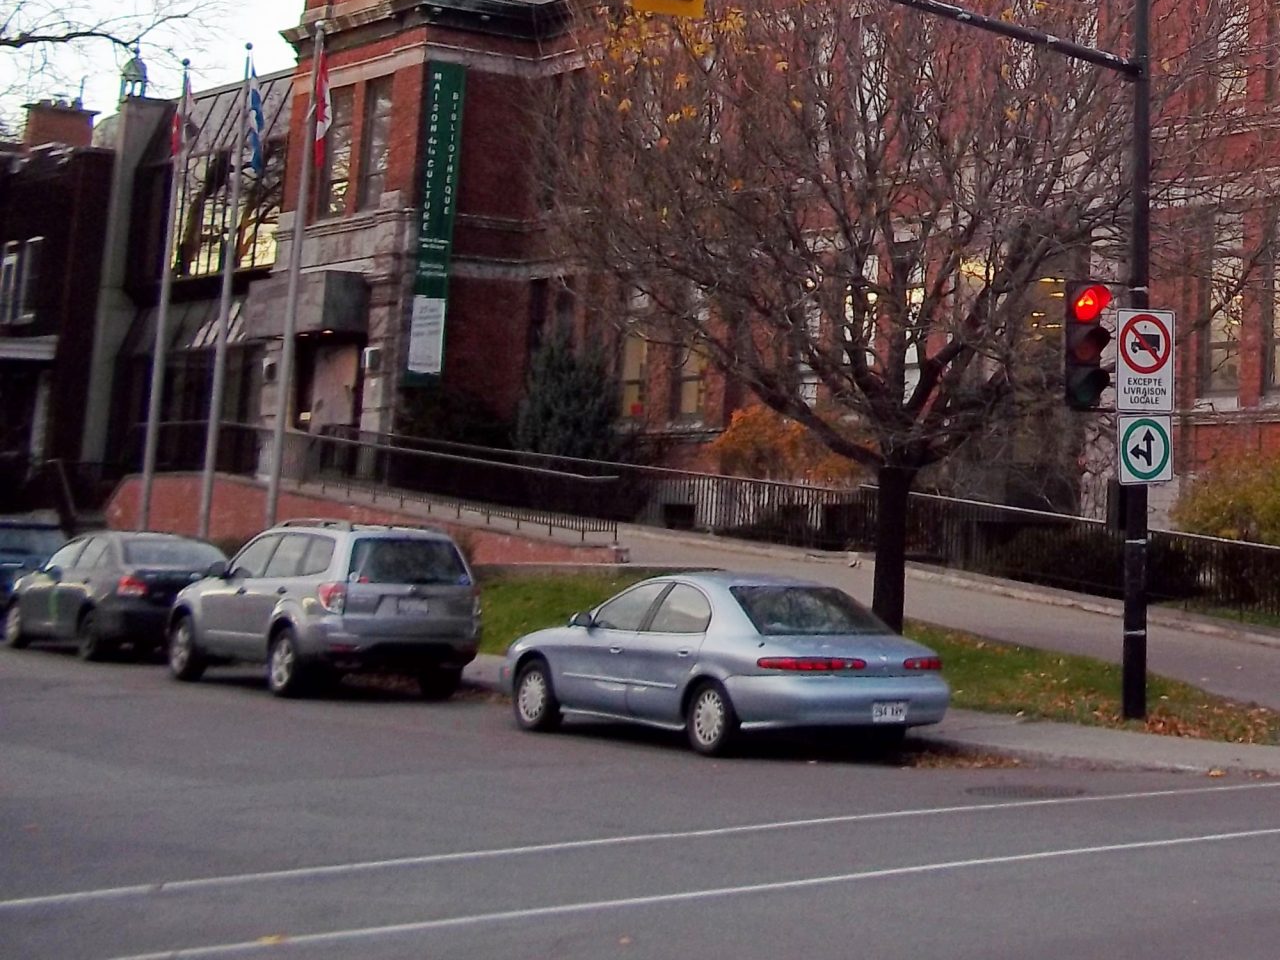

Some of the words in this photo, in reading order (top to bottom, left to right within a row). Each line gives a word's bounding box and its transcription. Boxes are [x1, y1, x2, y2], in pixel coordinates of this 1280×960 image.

[430, 72, 442, 132] MAISON
[423, 160, 435, 231] CULTURE
[1123, 387, 1167, 396] LIVRAISON
[1130, 396, 1160, 405] LOCALE
